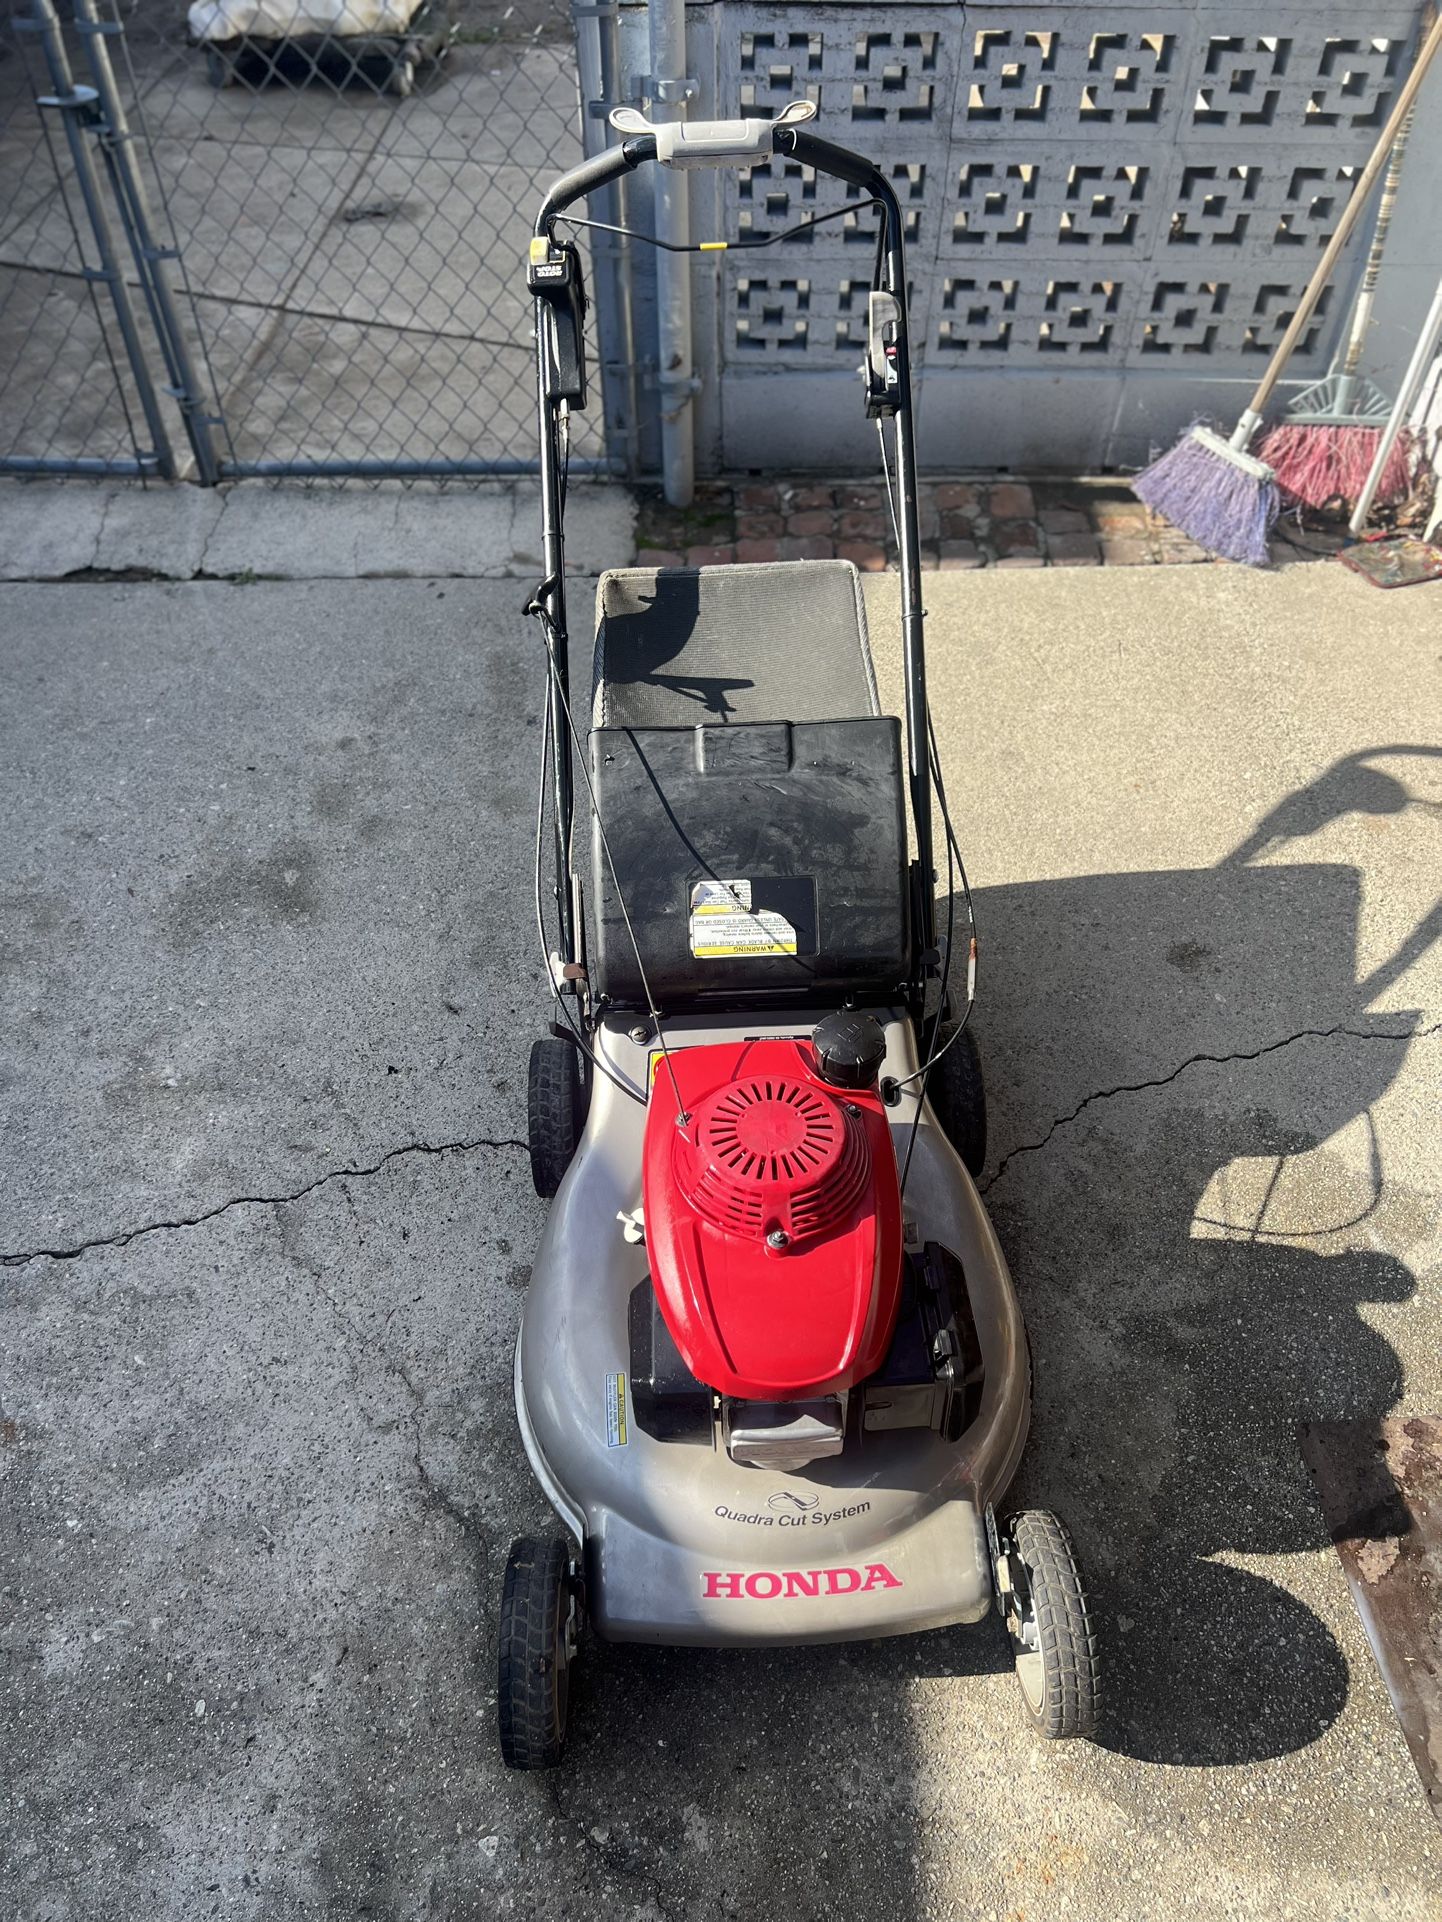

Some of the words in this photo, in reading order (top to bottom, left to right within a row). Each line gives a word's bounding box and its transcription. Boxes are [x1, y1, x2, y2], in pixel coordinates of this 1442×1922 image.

[714, 1505, 773, 1526] Quadra
[778, 1513, 807, 1527] Cut
[811, 1501, 871, 1525] System
[703, 1563, 903, 1599] HONDA
